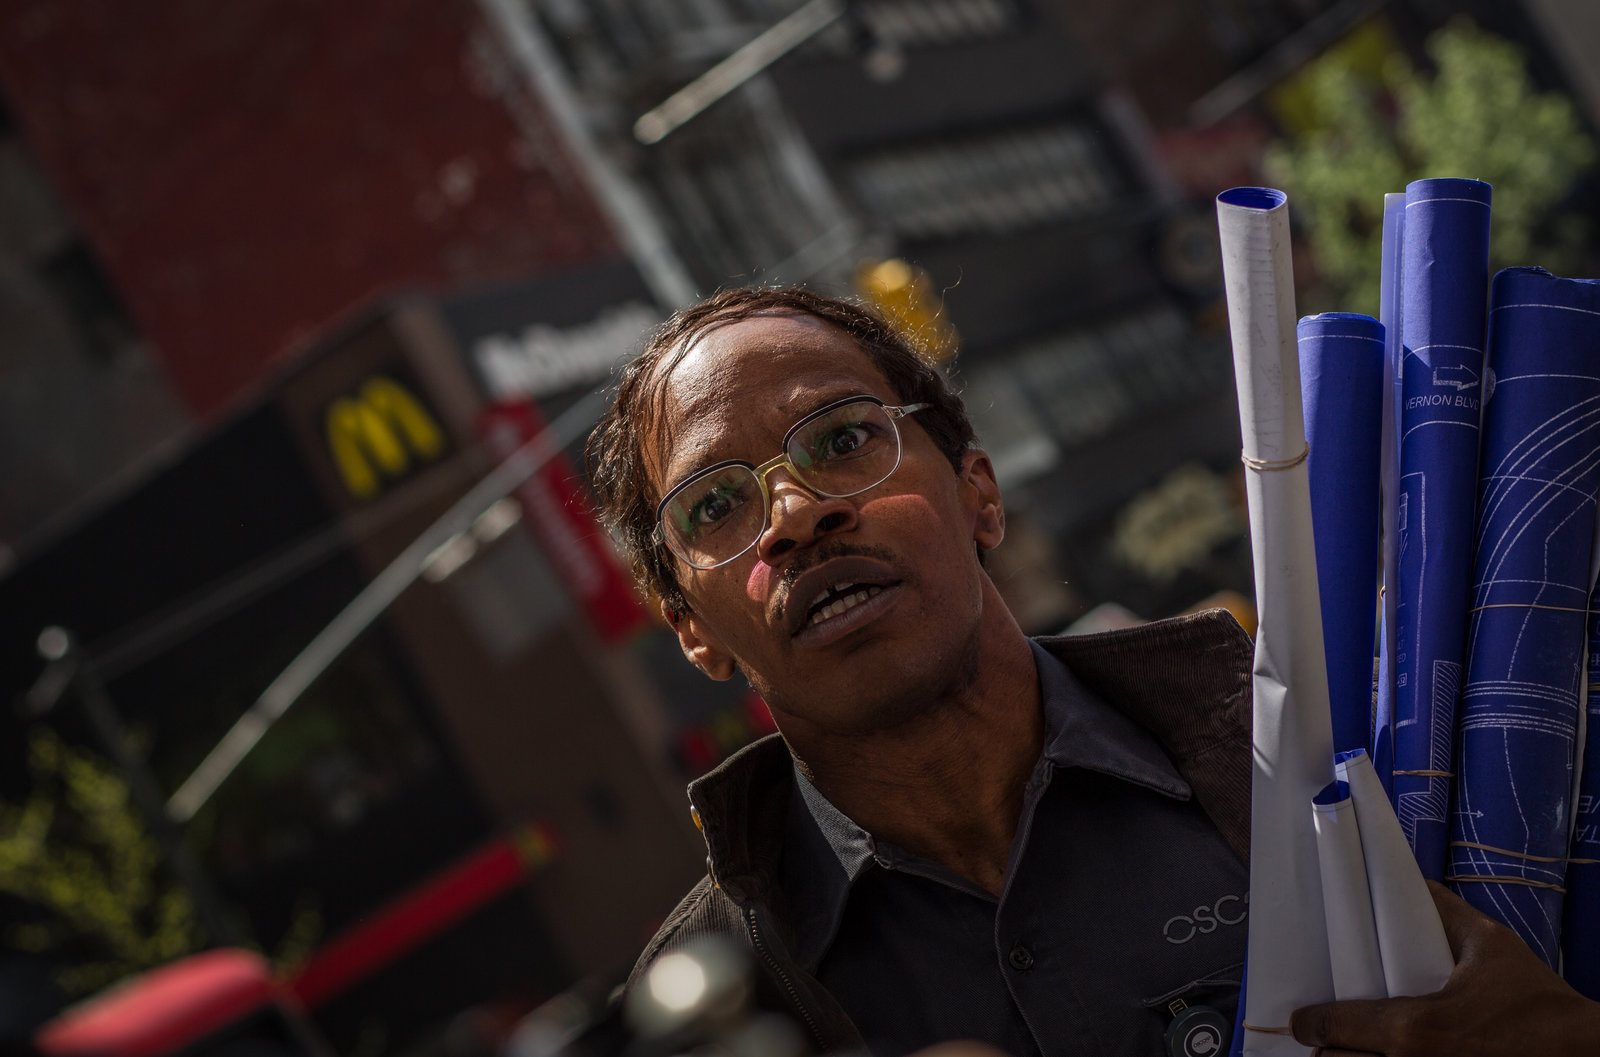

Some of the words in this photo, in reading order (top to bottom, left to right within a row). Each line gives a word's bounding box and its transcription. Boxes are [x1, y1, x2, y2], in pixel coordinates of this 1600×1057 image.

[1405, 394, 1453, 411] VERNON
[1454, 395, 1480, 411] BLVD
[1163, 891, 1250, 944] OSC
